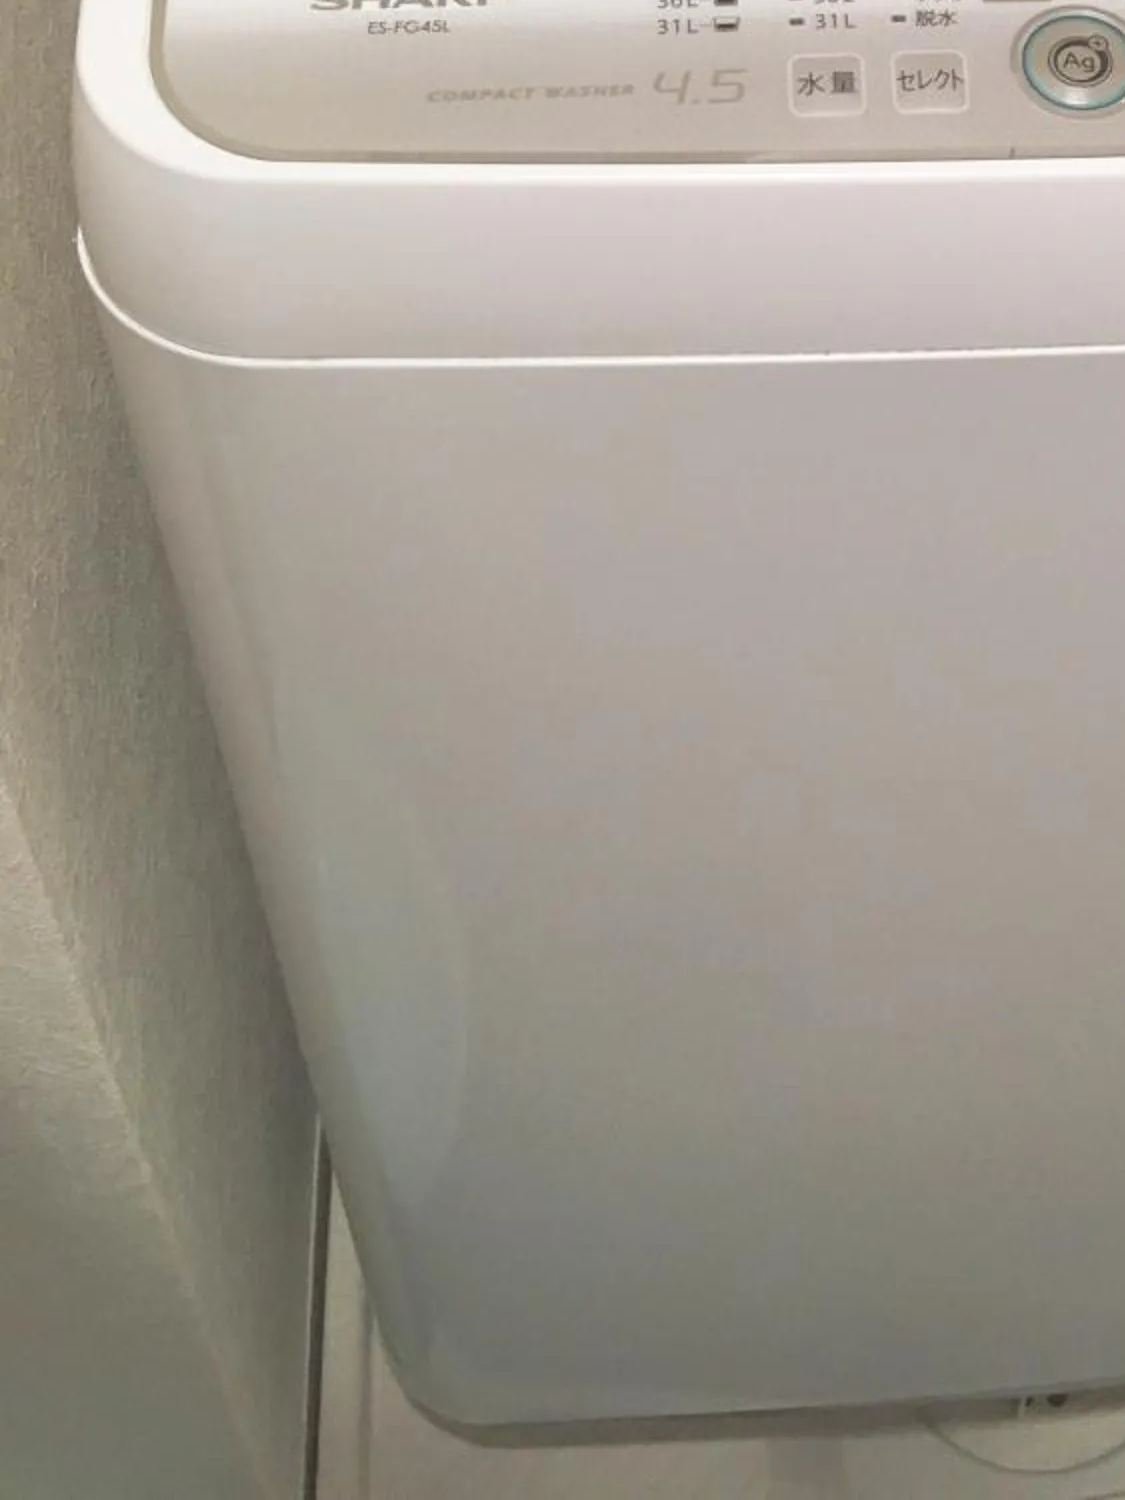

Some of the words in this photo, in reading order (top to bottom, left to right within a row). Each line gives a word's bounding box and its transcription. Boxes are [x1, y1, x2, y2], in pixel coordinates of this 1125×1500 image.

[657, 18, 700, 34] 31L
[815, 13, 857, 28] 31L
[915, 10, 957, 27] 脱水
[367, 20, 451, 35] ES-FG45L
[653, 69, 749, 106] 4.5
[797, 71, 856, 96] 水量
[896, 69, 965, 92] セレクト
